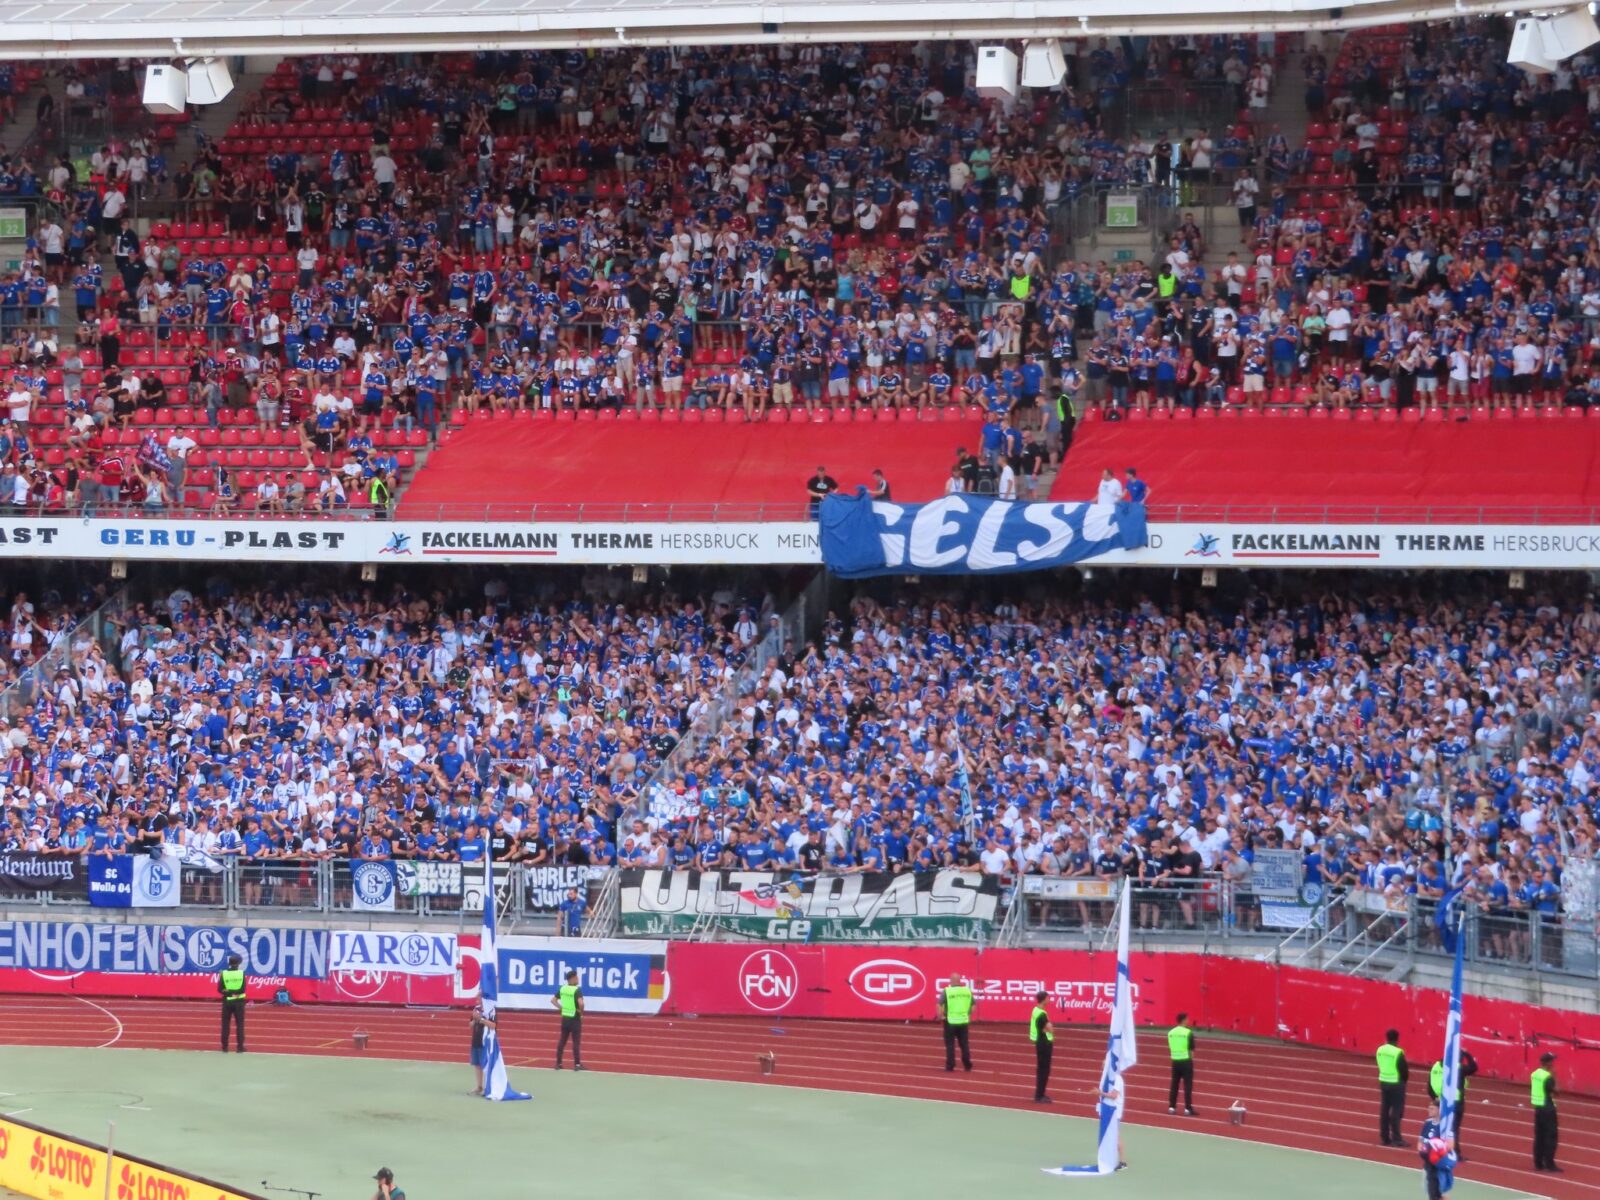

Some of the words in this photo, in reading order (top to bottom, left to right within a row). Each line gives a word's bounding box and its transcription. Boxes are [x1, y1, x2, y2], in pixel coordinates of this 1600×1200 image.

[422, 532, 558, 549] FACKELMANN
[571, 533, 653, 549] THERME
[661, 533, 759, 550] HERSBRUCK
[1232, 534, 1380, 551] FACKELMANN
[1395, 535, 1485, 551] THERME
[1493, 536, 1600, 552] HERSBRUCK
[105, 868, 118, 879] SC
[418, 862, 461, 878] BLUE
[525, 865, 588, 889] MARLER
[118, 883, 131, 894] 04
[418, 878, 461, 894] BOYZ
[760, 953, 775, 974] 1.
[248, 974, 287, 989] Logistics
[508, 957, 640, 990] Delbrück
[745, 974, 791, 997] FCN
[863, 973, 912, 993] GP
[1056, 997, 1097, 1009] Natural
[48, 1143, 93, 1189] LOTTO
